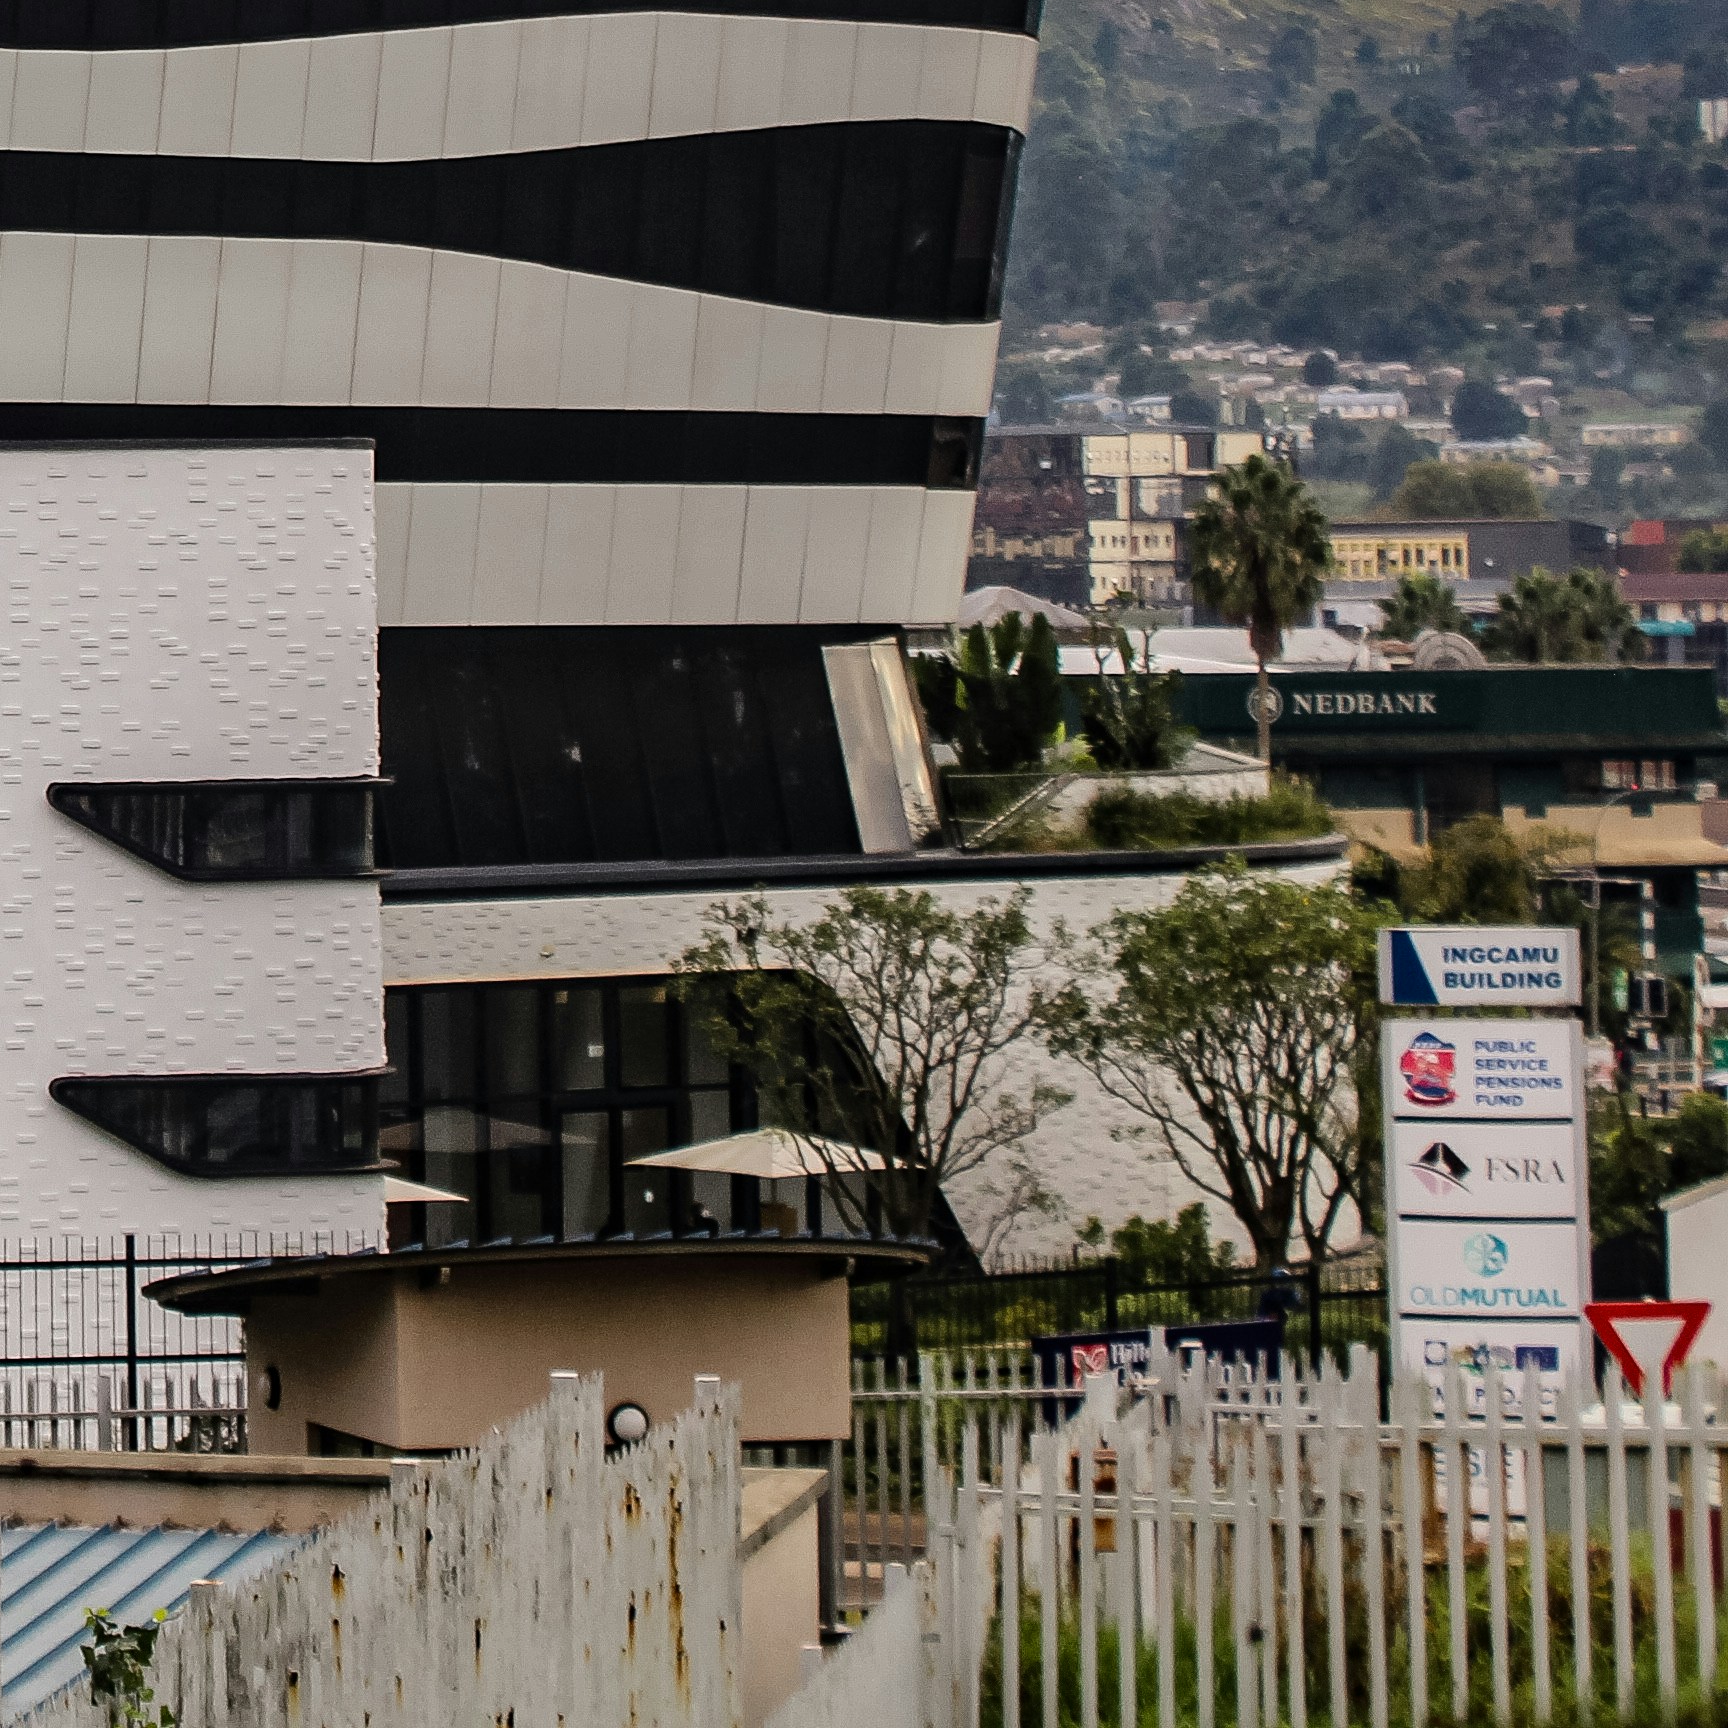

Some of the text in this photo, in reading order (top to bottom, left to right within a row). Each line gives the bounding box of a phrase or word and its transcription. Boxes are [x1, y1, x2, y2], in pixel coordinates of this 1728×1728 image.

[1292, 692, 1437, 714] NEDBANK
[1443, 947, 1559, 964] INGCAMU
[1444, 972, 1563, 989] BUILDING
[1474, 1040, 1536, 1053] PUBLIC
[1474, 1058, 1548, 1071] SERVICE
[1474, 1075, 1563, 1089] PENSIONS
[1474, 1094, 1524, 1106] FUND
[1486, 1157, 1565, 1184] FSRA
